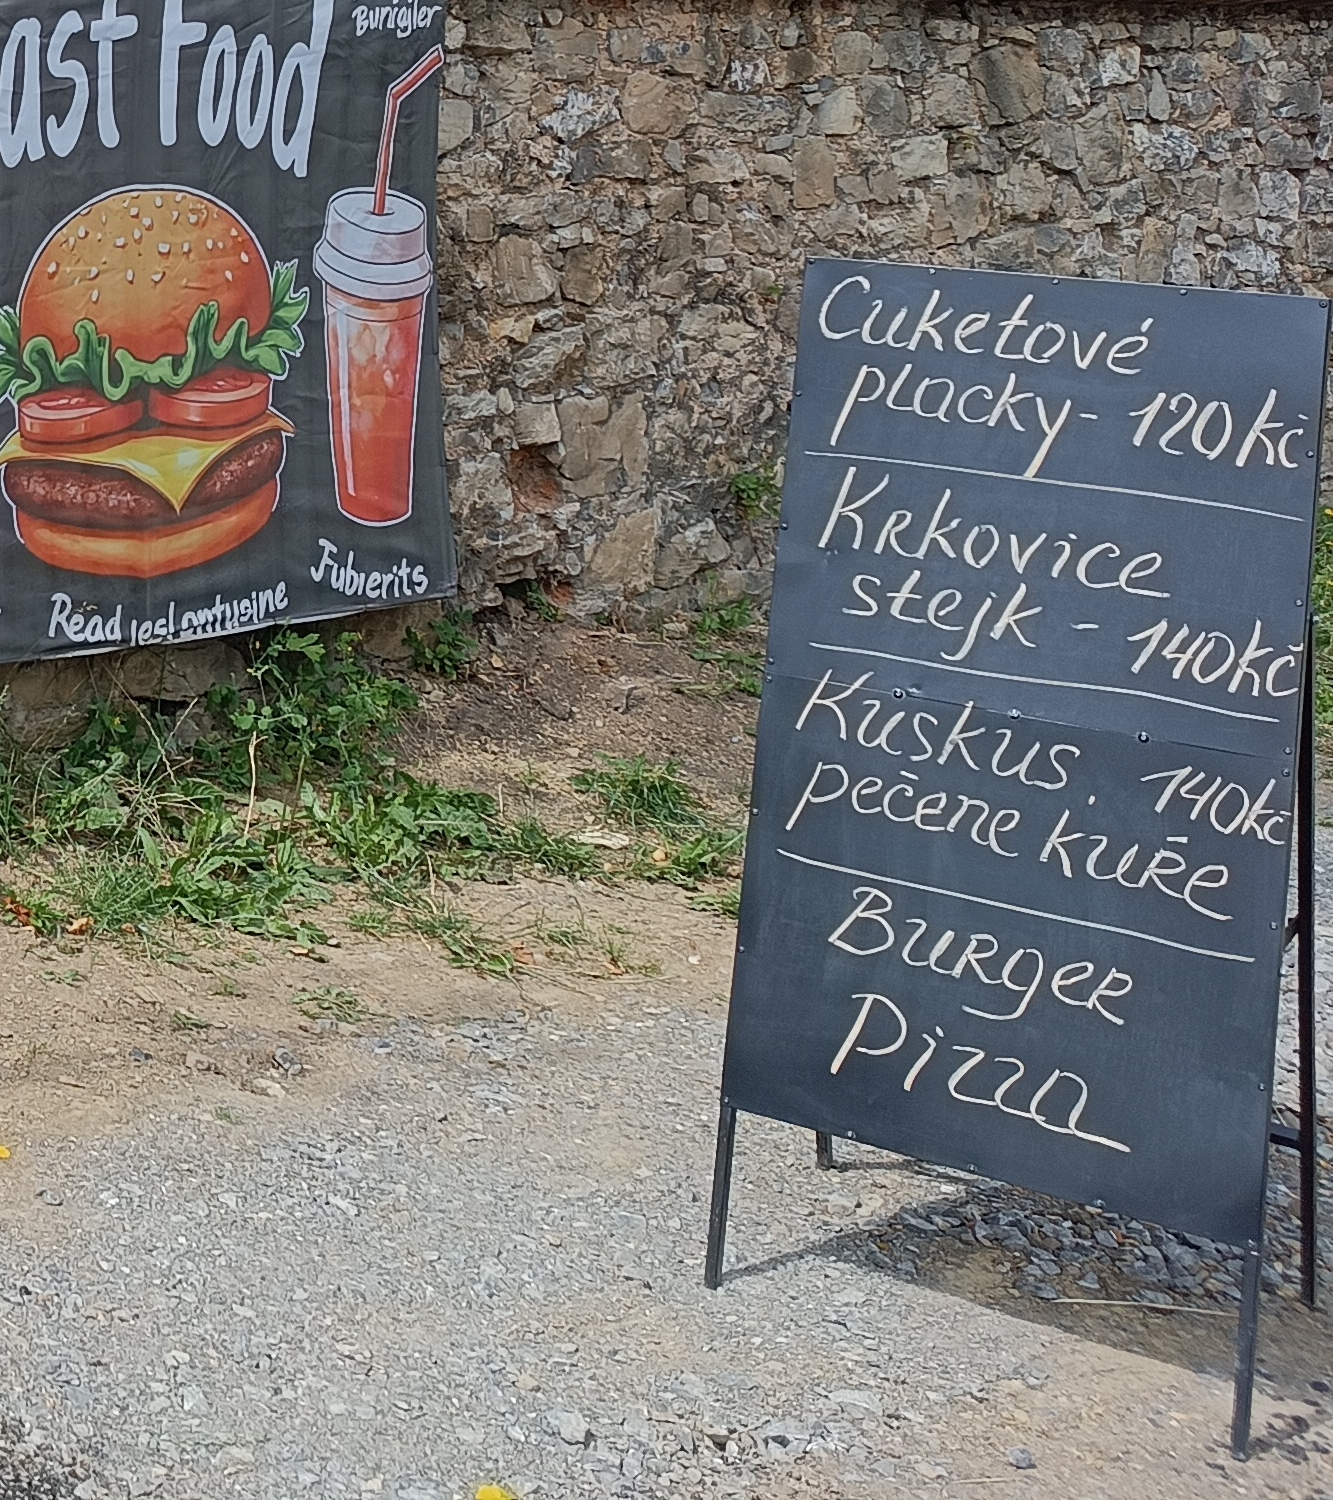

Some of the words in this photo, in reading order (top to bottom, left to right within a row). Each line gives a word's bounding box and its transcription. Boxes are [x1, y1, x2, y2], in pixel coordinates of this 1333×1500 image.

[816, 275, 1156, 375] Cuketové
[47, 592, 122, 643] Read
[842, 570, 1044, 662] stejk
[829, 993, 1132, 1154] Pizza
